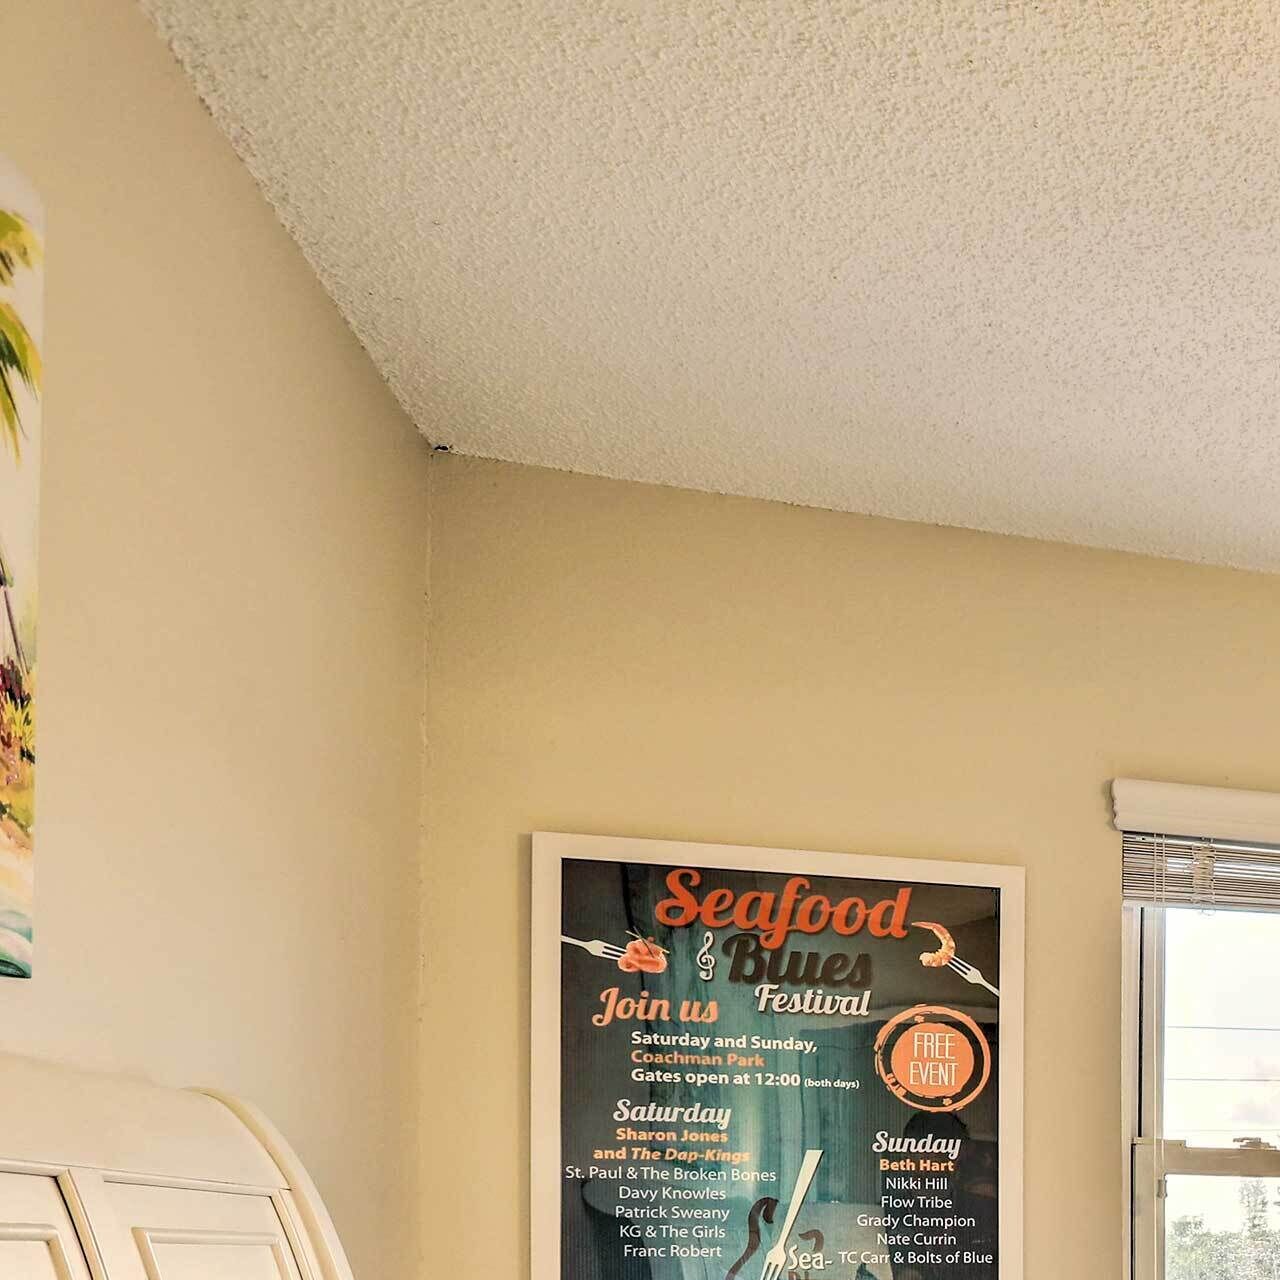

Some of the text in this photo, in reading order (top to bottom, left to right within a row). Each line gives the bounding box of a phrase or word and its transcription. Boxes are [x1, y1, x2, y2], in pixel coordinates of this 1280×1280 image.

[655, 868, 912, 950] Seafood
[722, 932, 872, 988] Blues
[592, 987, 719, 1026] Join us
[753, 984, 872, 1016] Festival
[631, 1031, 817, 1053] Saturday and Sunday,
[913, 1032, 955, 1059] FREE
[631, 1050, 765, 1067] Coachman Park
[631, 1068, 860, 1089] Gates open at 12:00 (both days)
[909, 1061, 958, 1086] EVENT
[613, 1098, 732, 1130] Saturday
[616, 1127, 729, 1143] Sharon Jones
[872, 1131, 961, 1159] Sunday
[593, 1147, 751, 1164] and The Dap-Kings
[565, 1165, 777, 1181] St. Paul & The Broken Bones
[880, 1158, 955, 1171] Beth Hart
[886, 1177, 948, 1190] Nikki Hill
[618, 1186, 727, 1201] Davy Knowles
[881, 1195, 953, 1209] Flow Tribe
[615, 1206, 730, 1221] Patrick Sweany
[856, 1214, 976, 1229] Grady Champion
[619, 1225, 726, 1238] KG & The Girls
[877, 1233, 957, 1245] Nate Currin
[623, 1245, 722, 1258] Franc Robert
[787, 1244, 833, 1270] Sea-
[838, 1251, 993, 1264] TC Carr & Bolts of Blue
